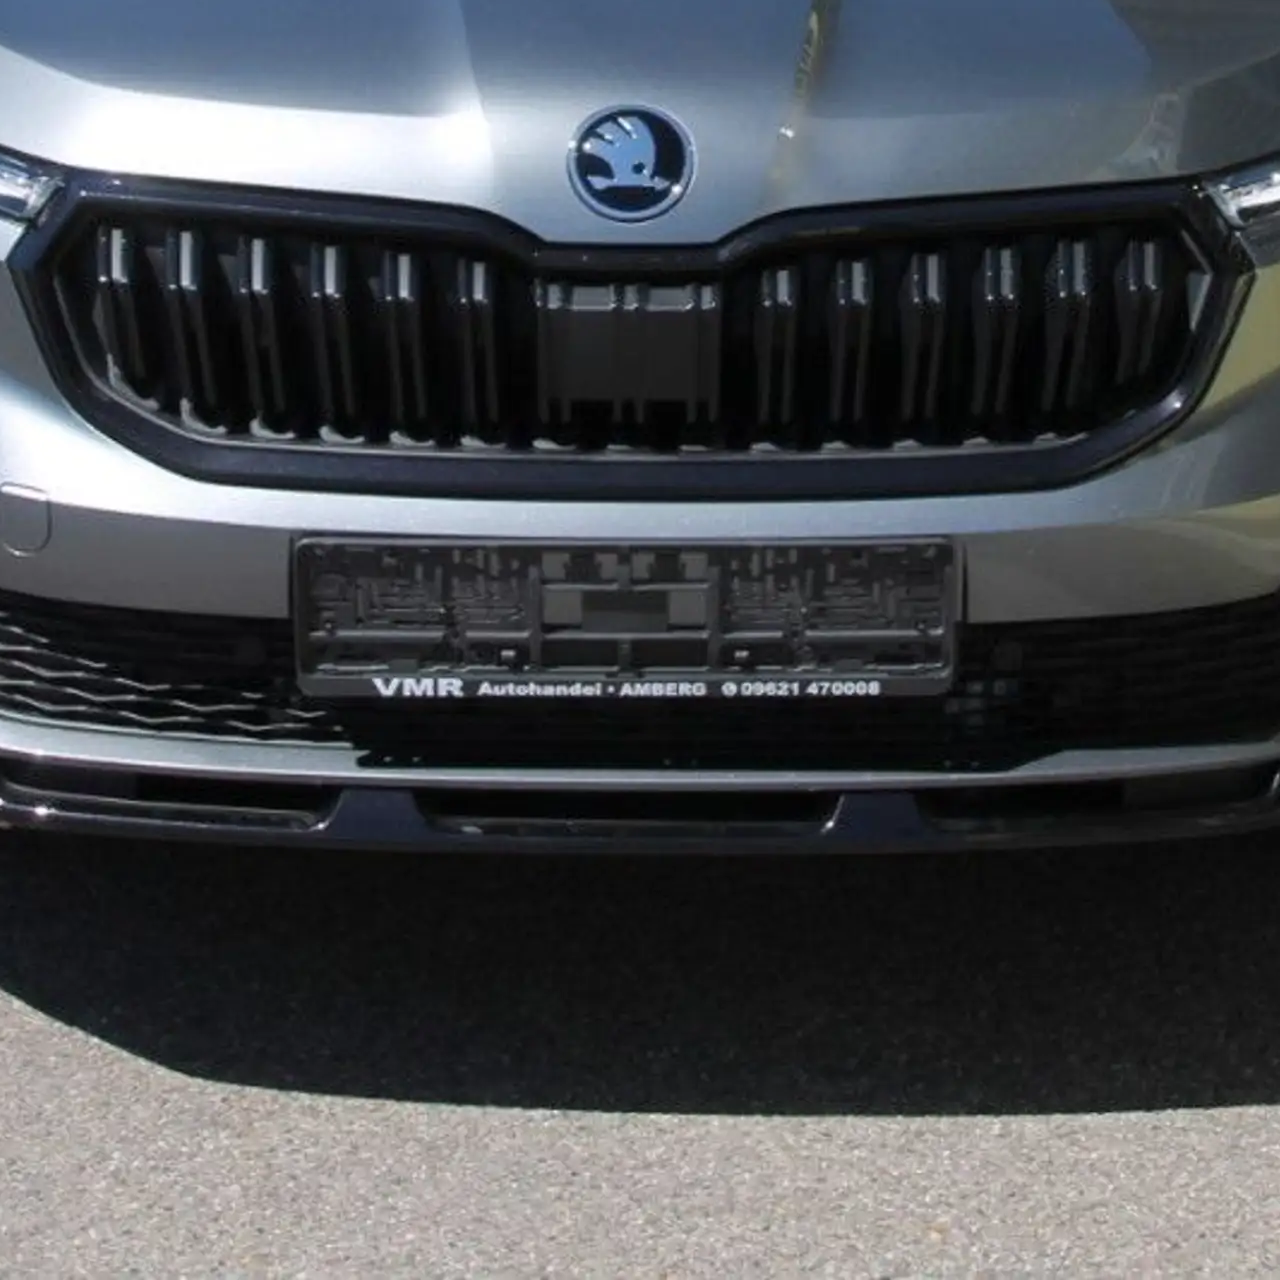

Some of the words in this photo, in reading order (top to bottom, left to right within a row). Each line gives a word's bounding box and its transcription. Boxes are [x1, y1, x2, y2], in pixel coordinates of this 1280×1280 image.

[371, 677, 464, 697] VMR
[476, 681, 602, 697] Autohandel
[619, 682, 707, 697] AMBERG
[740, 681, 800, 697] 09621
[806, 680, 881, 696] 470008
